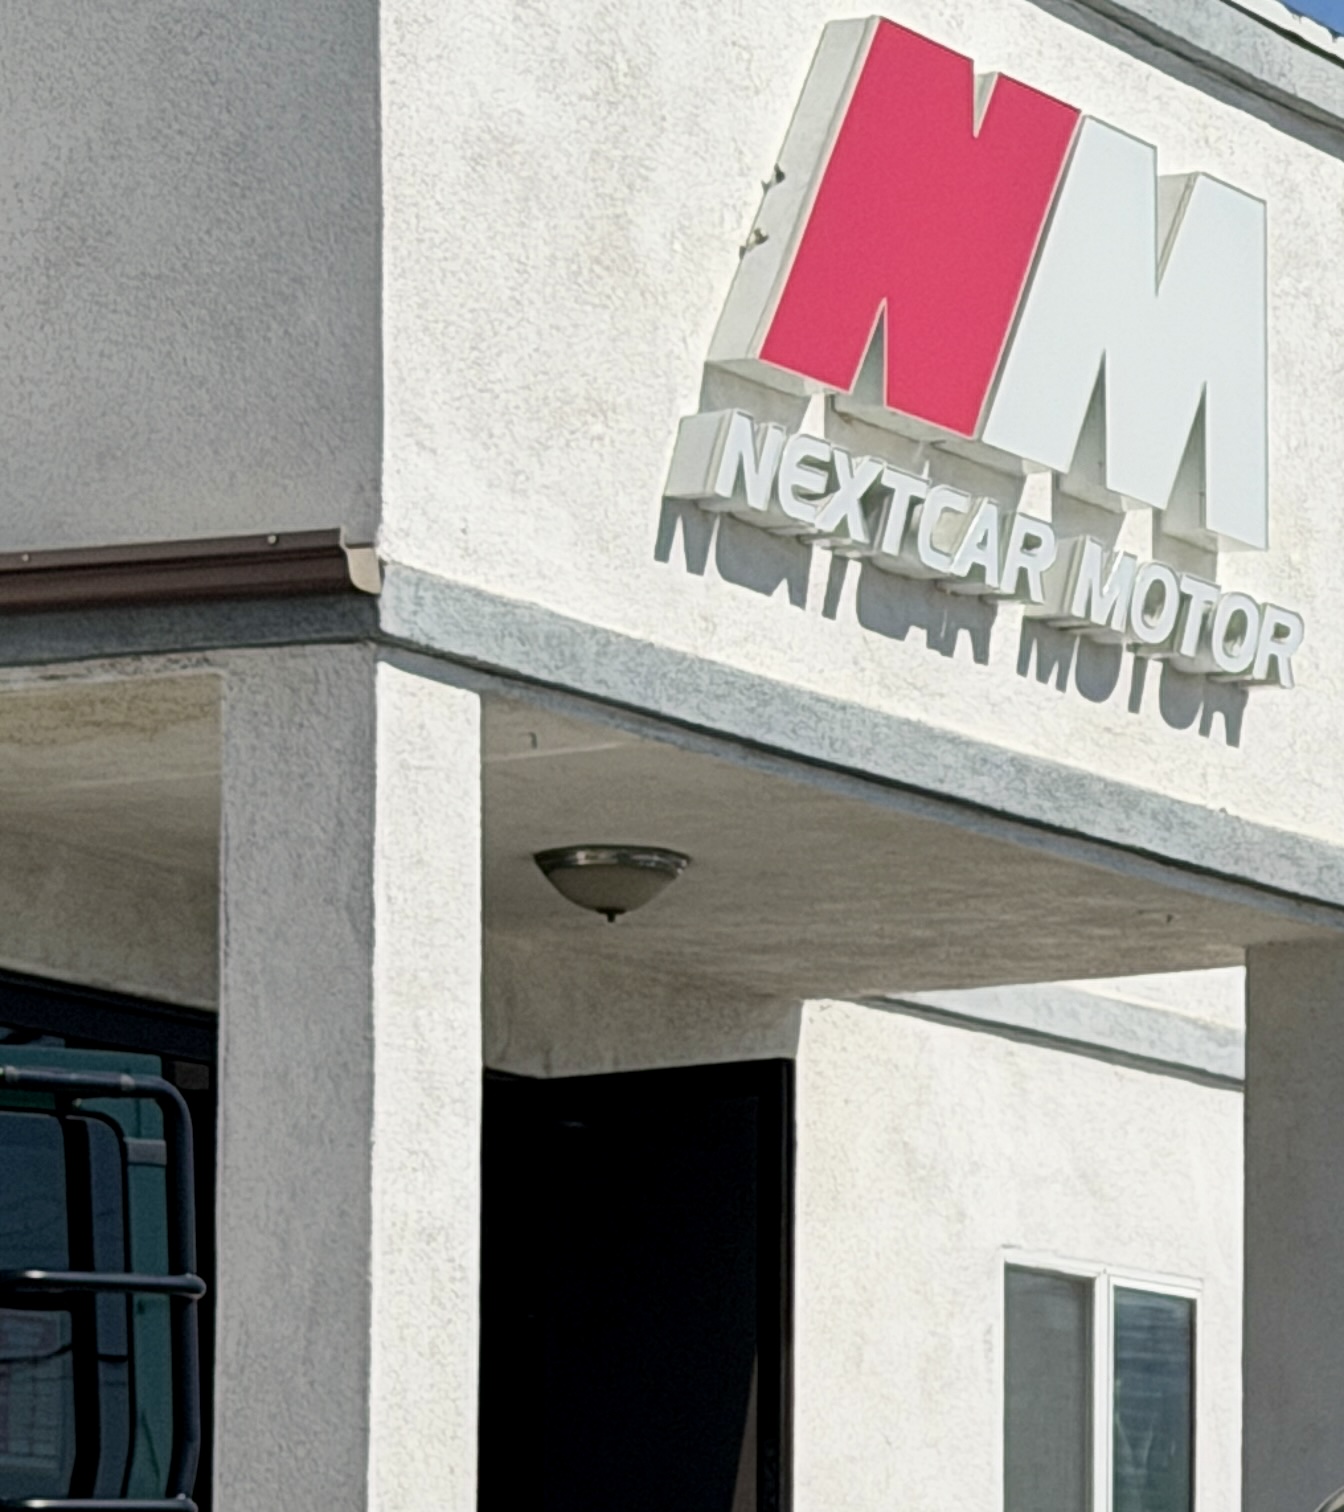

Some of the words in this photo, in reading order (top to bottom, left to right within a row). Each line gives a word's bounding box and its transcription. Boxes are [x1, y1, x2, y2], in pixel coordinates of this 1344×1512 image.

[758, 15, 1268, 552] NM
[713, 408, 1057, 604] NEXTCAR
[1071, 536, 1304, 689] MOTOR
